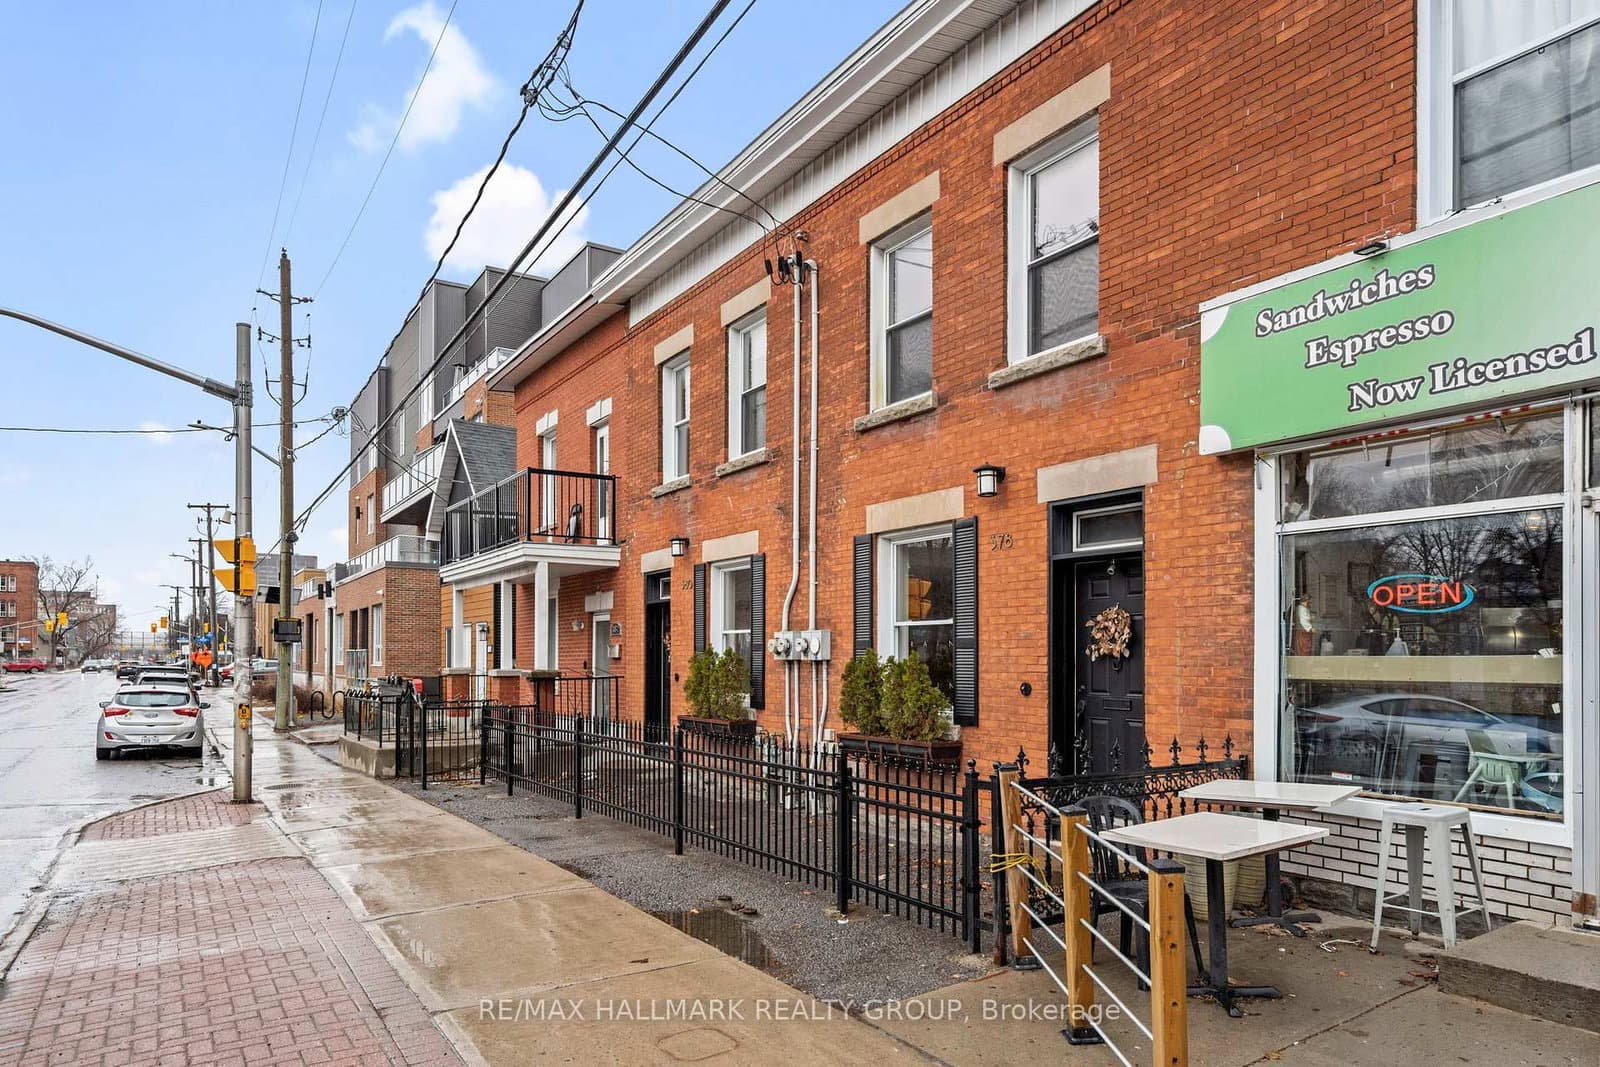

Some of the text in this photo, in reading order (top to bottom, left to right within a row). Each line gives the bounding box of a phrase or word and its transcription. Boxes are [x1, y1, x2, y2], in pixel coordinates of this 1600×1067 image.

[1256, 264, 1435, 337] Sandwiches
[1305, 310, 1454, 368] Espresso
[1348, 326, 1595, 412] Now Licensed
[1373, 581, 1462, 607] OPEN
